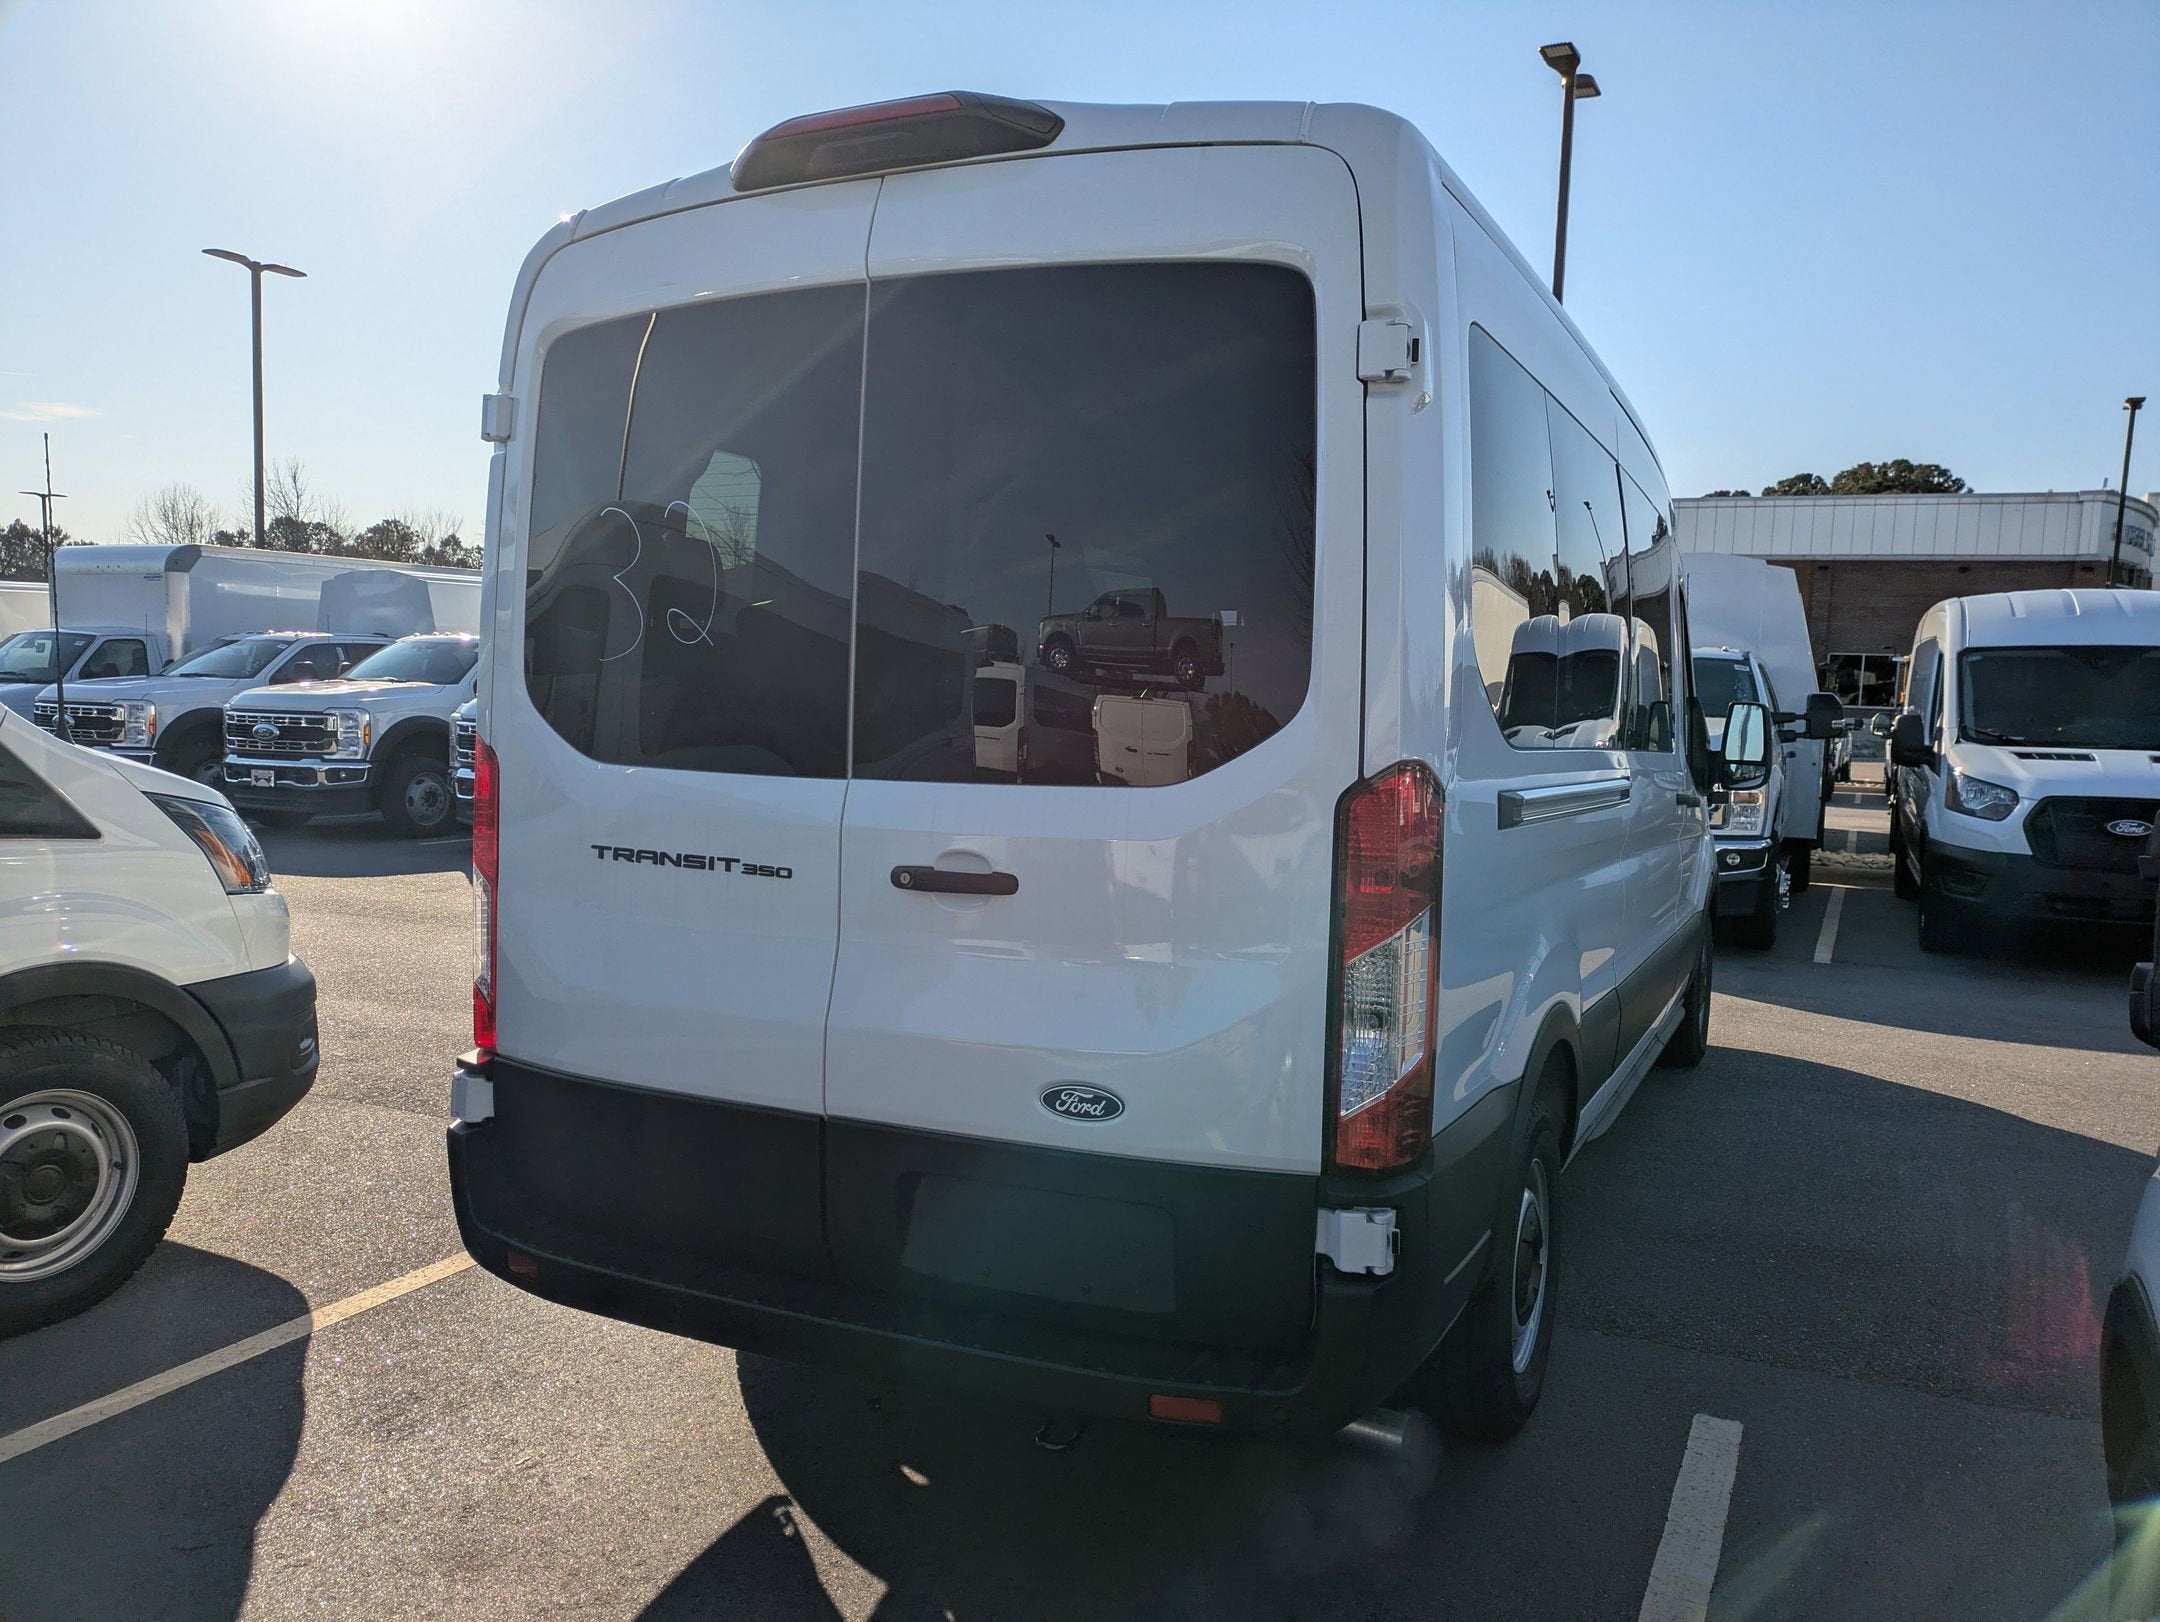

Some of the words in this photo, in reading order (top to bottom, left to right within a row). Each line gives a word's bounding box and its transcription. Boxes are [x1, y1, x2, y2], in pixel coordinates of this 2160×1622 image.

[2116, 822, 2146, 833] Ford
[591, 844, 741, 873] TRANSIT
[741, 863, 793, 880] 350
[1056, 1090, 1107, 1116] Ford
